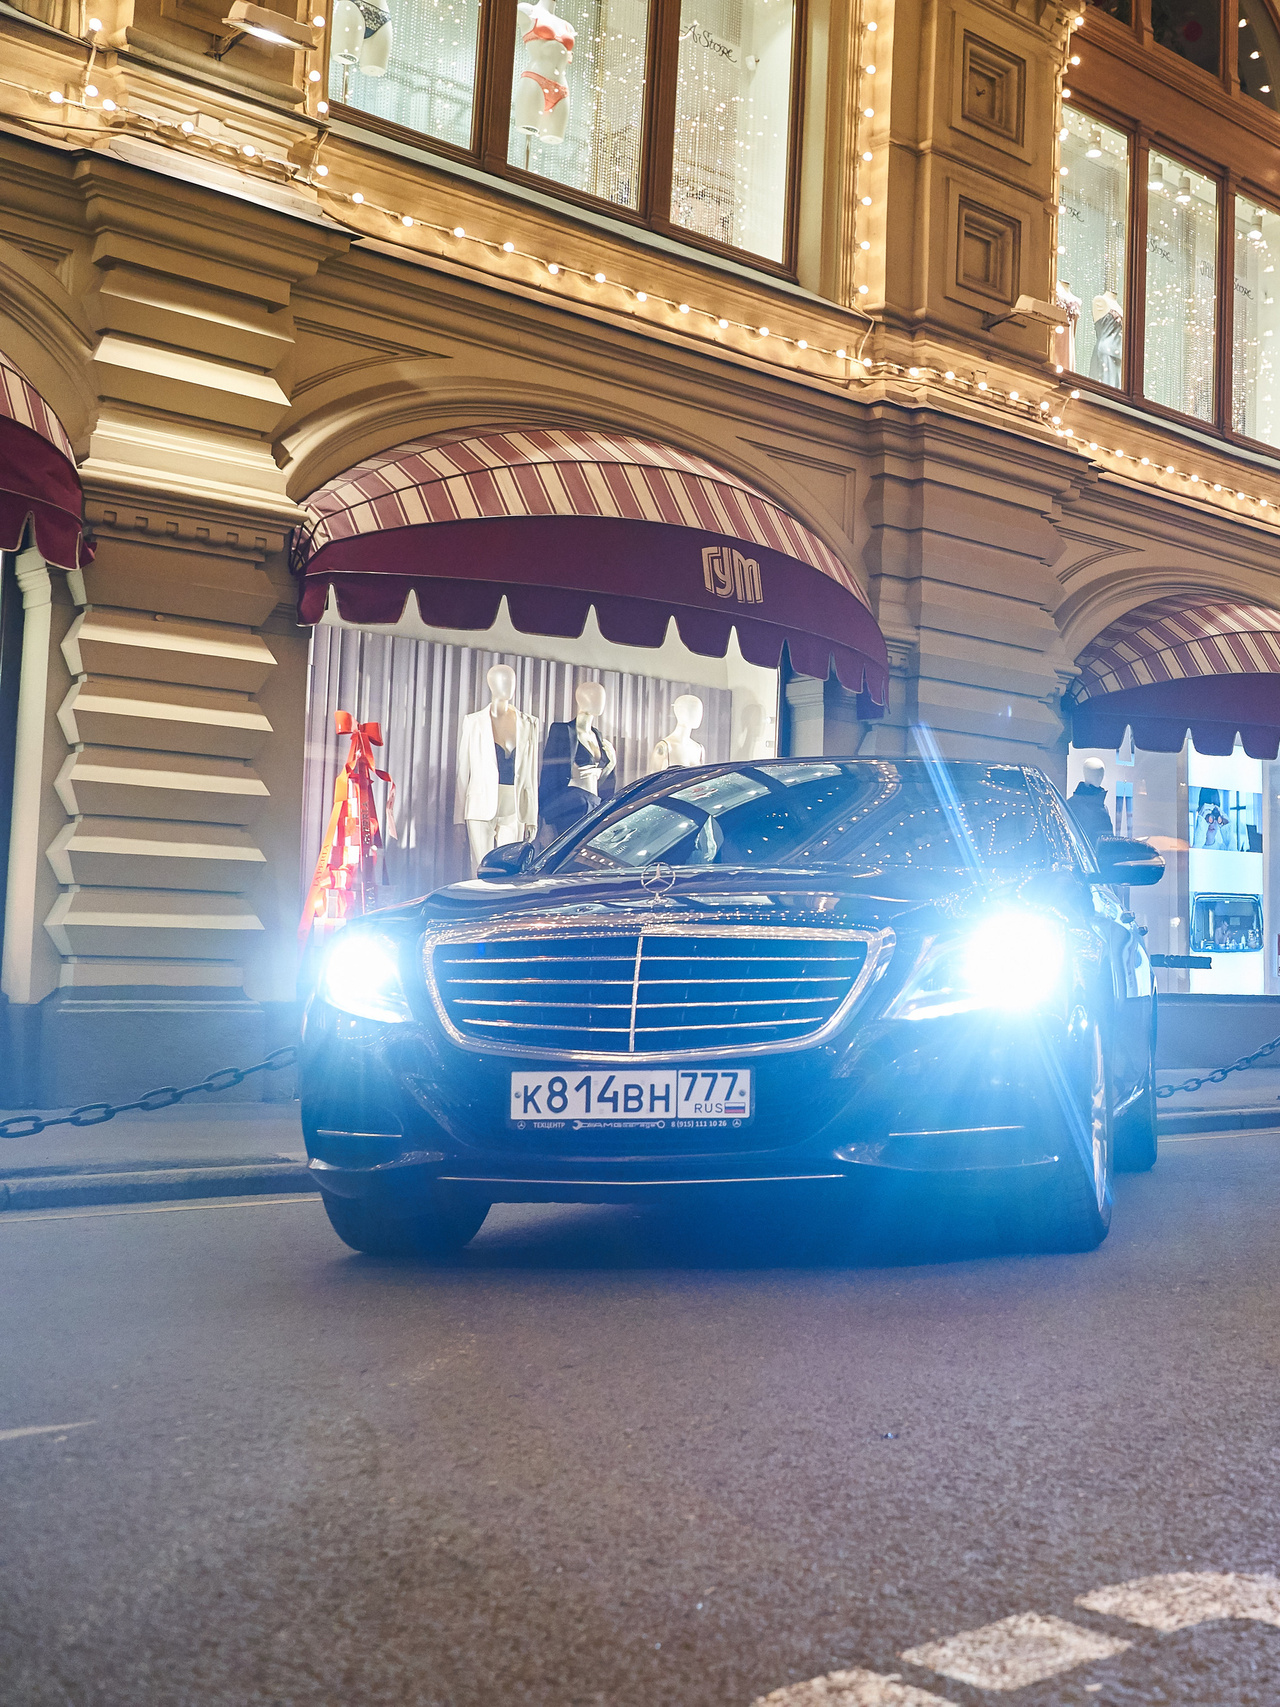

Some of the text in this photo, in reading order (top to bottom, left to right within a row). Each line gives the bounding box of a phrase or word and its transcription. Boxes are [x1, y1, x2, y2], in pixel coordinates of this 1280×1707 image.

[680, 1072, 739, 1102] 777
[694, 1102, 723, 1114] RUS
[533, 1121, 566, 1129] ТЕХЦЕНТР
[676, 1120, 694, 1128] (915)
